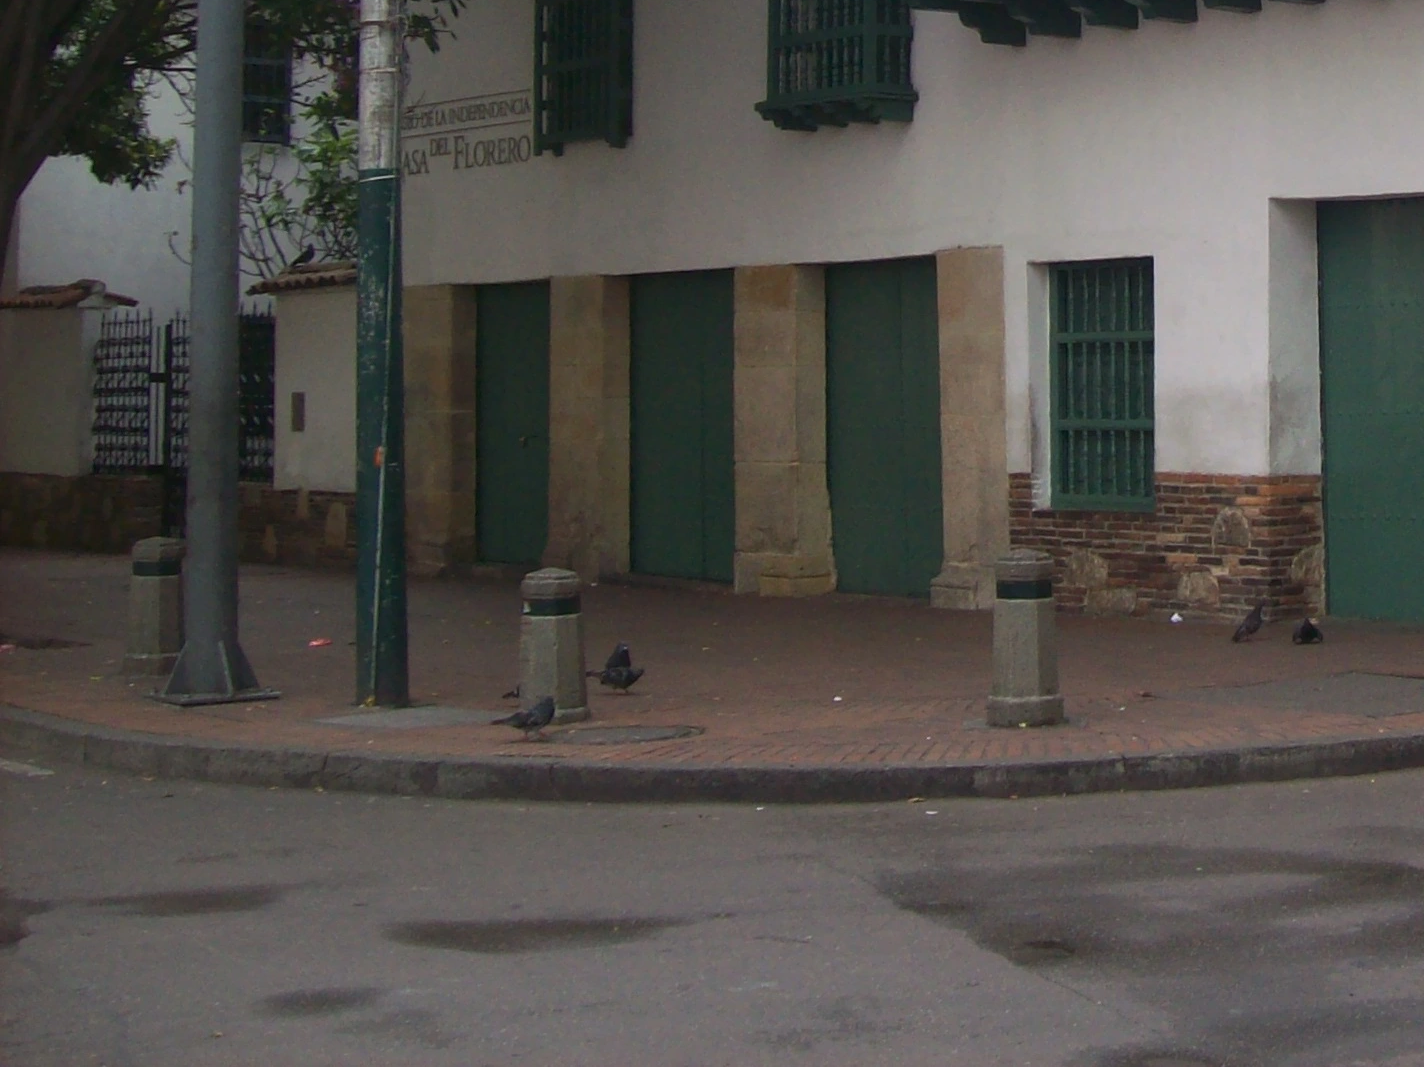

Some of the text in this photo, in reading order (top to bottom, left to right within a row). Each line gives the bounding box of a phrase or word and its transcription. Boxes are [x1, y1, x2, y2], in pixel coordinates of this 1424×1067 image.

[435, 108, 447, 127] LA
[449, 98, 530, 124] INDEPENDENCIA
[402, 136, 531, 174] ASA DEL FLORERO
